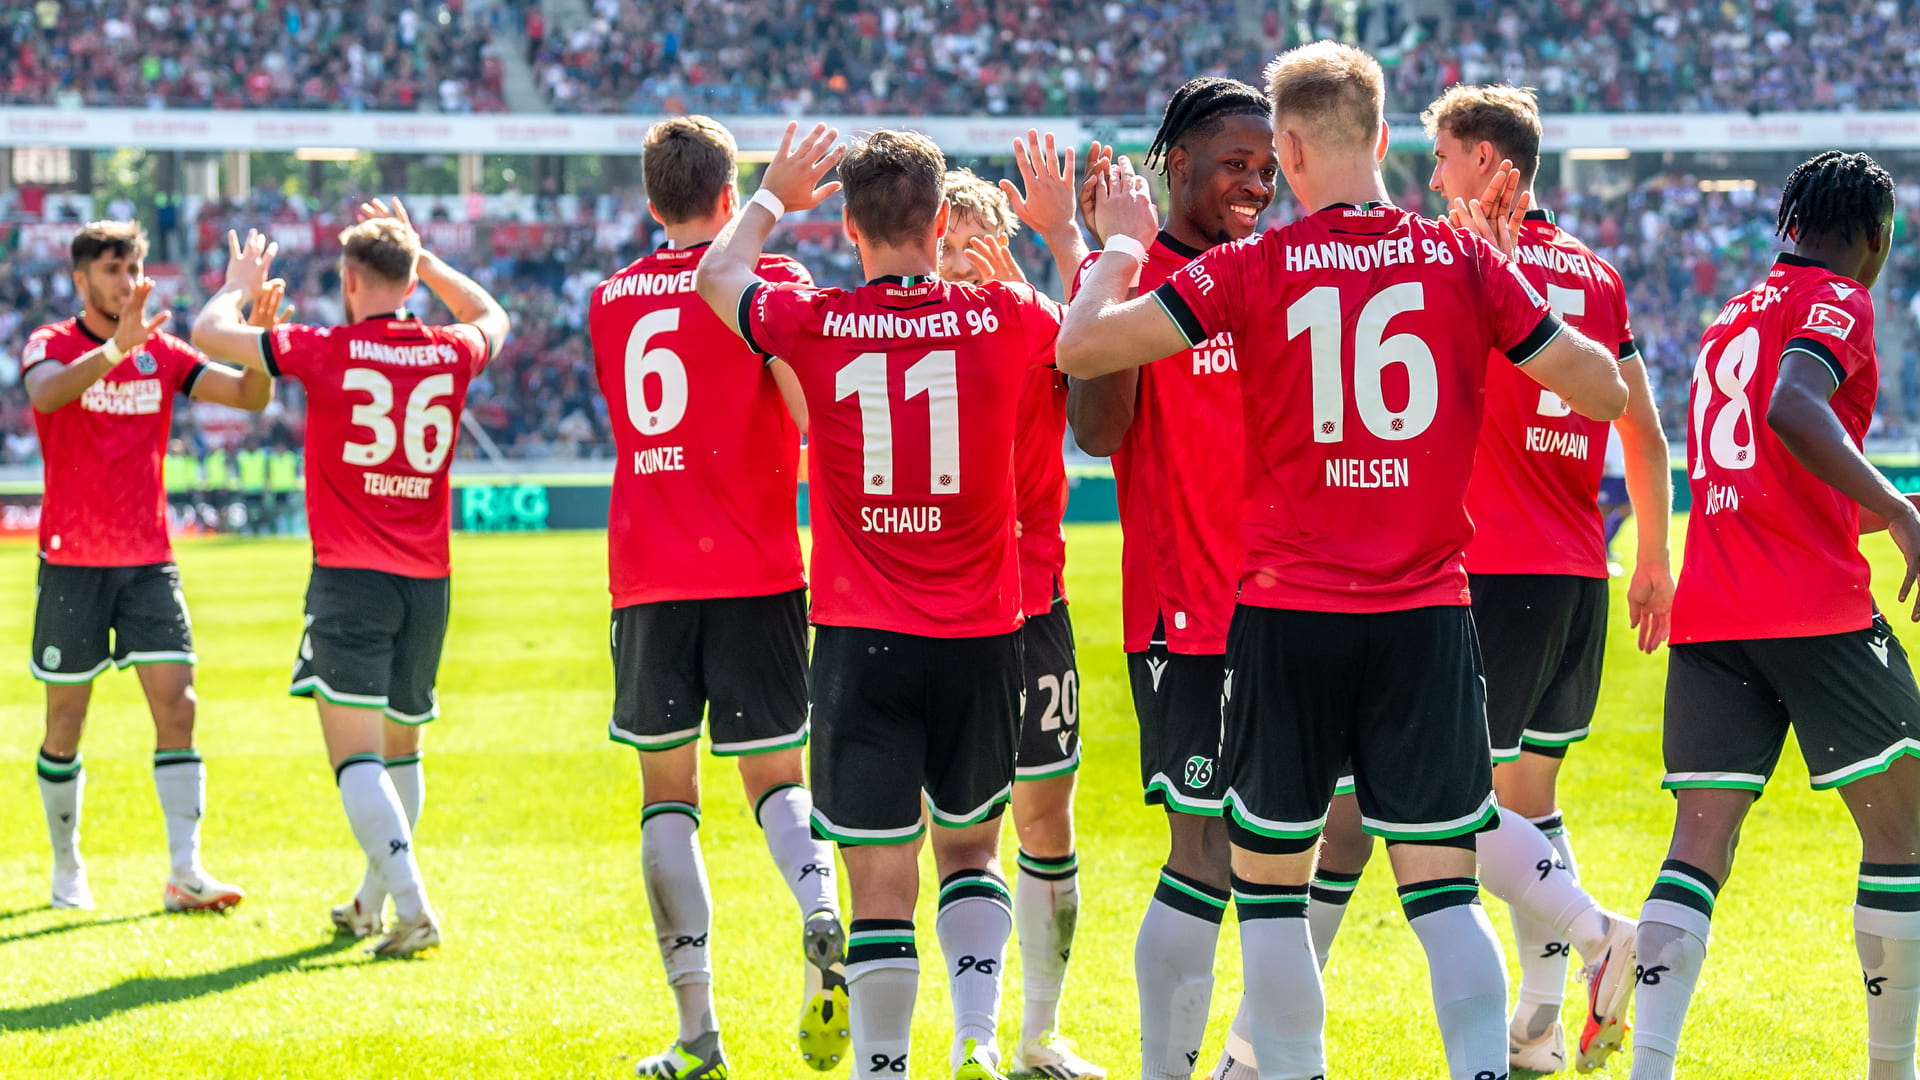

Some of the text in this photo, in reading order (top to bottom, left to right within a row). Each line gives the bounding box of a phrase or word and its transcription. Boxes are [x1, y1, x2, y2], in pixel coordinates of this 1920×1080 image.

[1285, 238, 1454, 272] HANNOVER 96
[823, 307, 999, 339] HANNOVER 96
[349, 340, 438, 366] HANNOVER
[1287, 281, 1438, 443] 16
[625, 308, 689, 436] 6
[1692, 326, 1760, 480] 18
[342, 368, 454, 474] 36
[835, 350, 960, 495] 11
[634, 446, 685, 475] KUNZE
[1325, 458, 1409, 488] NIELSEN
[363, 472, 433, 499] TEUCHERT
[861, 506, 942, 533] SCHAUB
[1037, 669, 1077, 731] 20
[1185, 756, 1213, 788] 96
[672, 931, 708, 950] 96
[955, 955, 997, 977] 96
[1635, 964, 1670, 989] 96
[869, 1053, 907, 1073] 96
